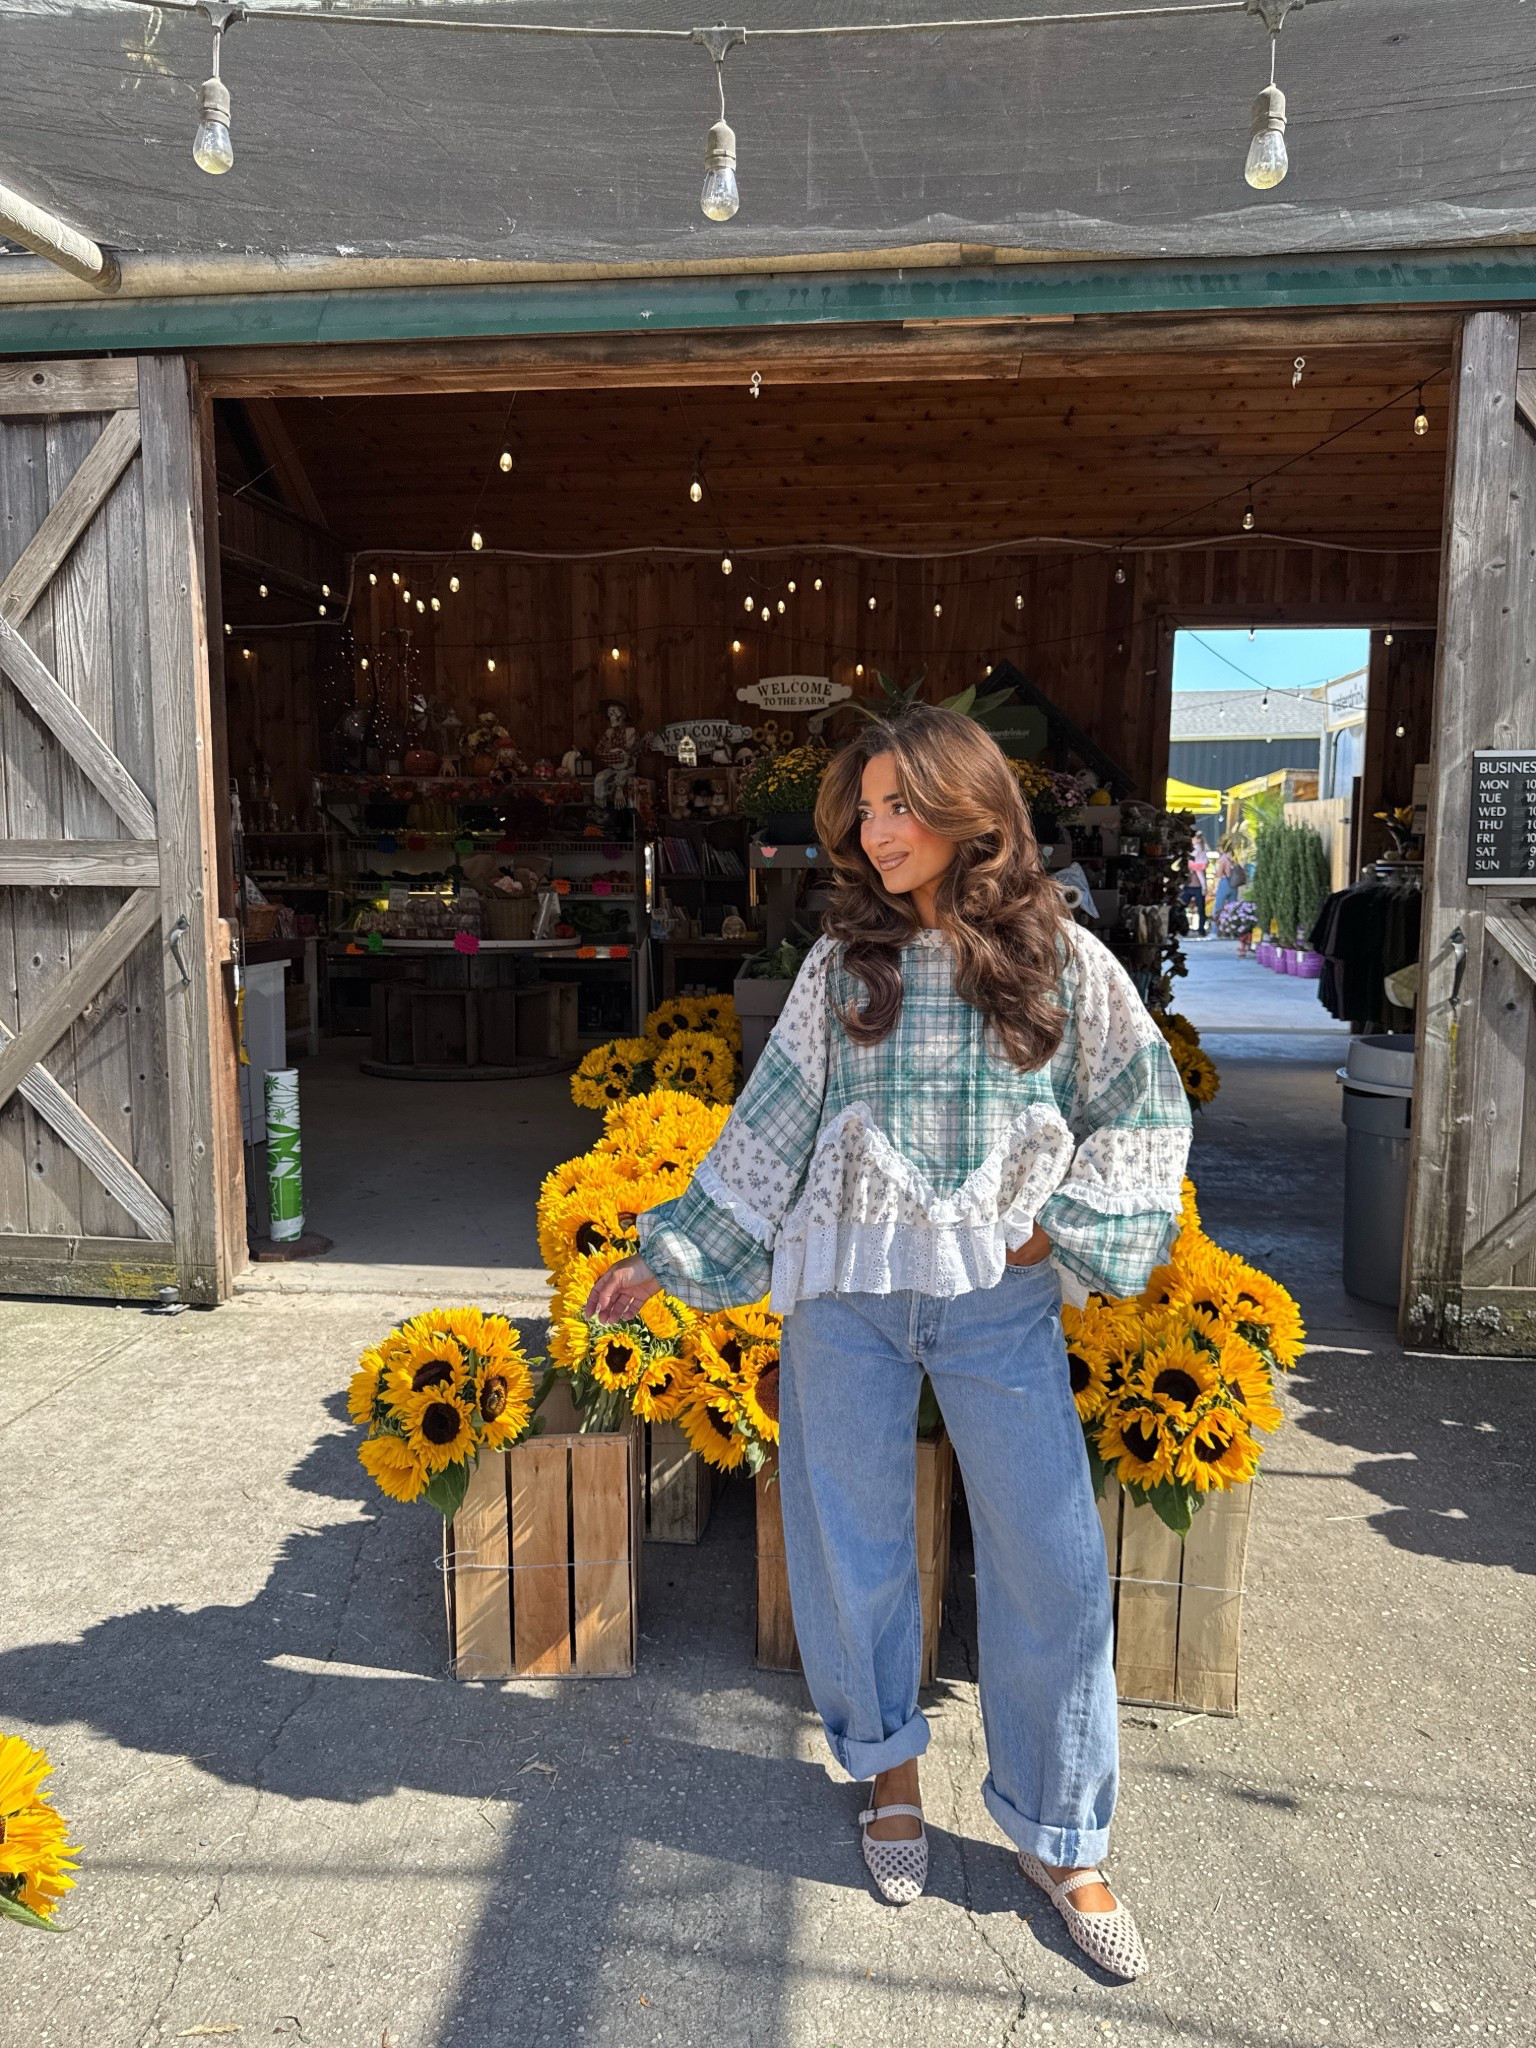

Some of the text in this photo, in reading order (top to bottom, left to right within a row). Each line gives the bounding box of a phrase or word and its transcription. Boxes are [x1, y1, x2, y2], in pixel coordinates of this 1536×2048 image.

[757, 682, 832, 697] WELCOME
[765, 697, 825, 706] TO THE FARM
[660, 725, 733, 743] WELCOME
[665, 744, 678, 753] TO
[1479, 761, 1536, 774] BUSINES
[1479, 779, 1536, 790] MON 10
[1479, 793, 1536, 803] TUE 10
[1478, 807, 1507, 817] WED
[1478, 820, 1504, 830] THU
[1476, 833, 1536, 843] FRI 10
[1475, 847, 1497, 857] SAT
[1474, 860, 1535, 870] SUN 9
